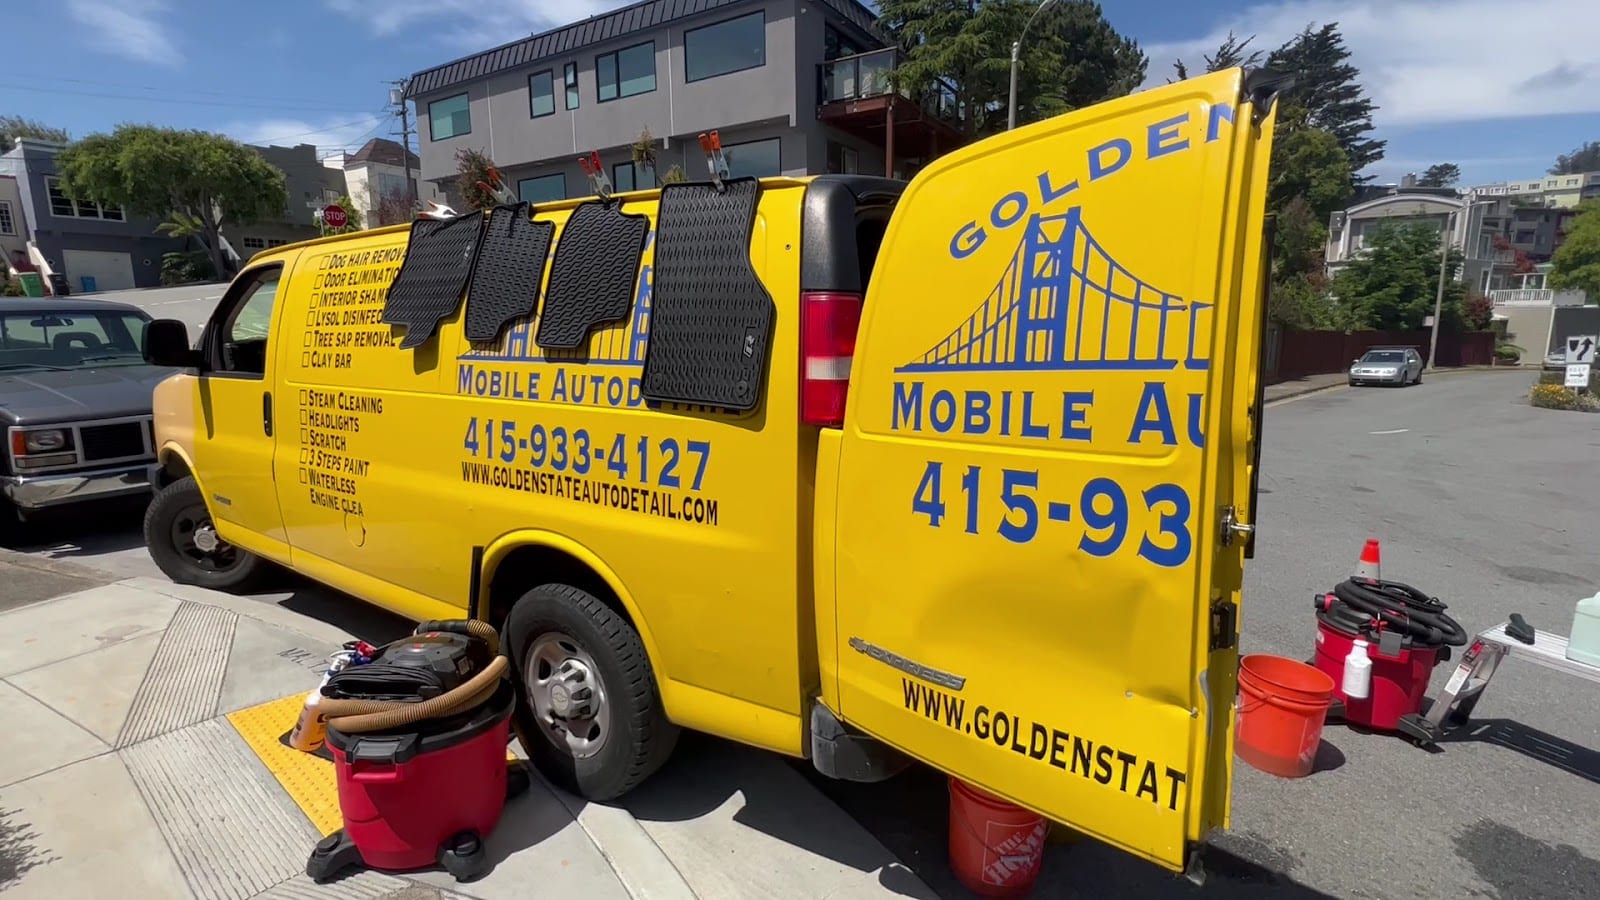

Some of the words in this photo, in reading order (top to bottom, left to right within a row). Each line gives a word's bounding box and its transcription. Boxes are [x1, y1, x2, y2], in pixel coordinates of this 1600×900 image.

[325, 211, 346, 221] STOP
[329, 253, 346, 270] DOG
[349, 251, 369, 266] HAIR
[324, 271, 345, 288] ODOR
[319, 290, 356, 308] INTERIOR
[315, 310, 339, 327] LYSOL
[314, 330, 334, 347] TREE
[336, 331, 352, 347] SAP
[355, 331, 396, 347] REMOVAL
[311, 350, 332, 368] CLAY
[335, 353, 352, 368] BAR
[456, 363, 541, 400] MOBILE
[309, 389, 336, 409] STEAM
[338, 392, 383, 414] CLEANING
[891, 381, 1095, 443] MOBILE
[309, 410, 360, 432] HEADLIGHTS
[310, 430, 347, 451] SCRATCH
[309, 449, 315, 466] 3
[316, 451, 342, 471] STEPS
[344, 458, 370, 477] PAINT
[464, 416, 711, 492] 415-933-4127
[309, 469, 356, 495] WATERLESS
[461, 461, 718, 526] WWW.GOLDENSTATEAUTODETAIL.COM
[310, 488, 340, 511] ENGINE
[912, 460, 1192, 568] 415-93
[902, 677, 1187, 811] WWW.GOLDENSTAT
